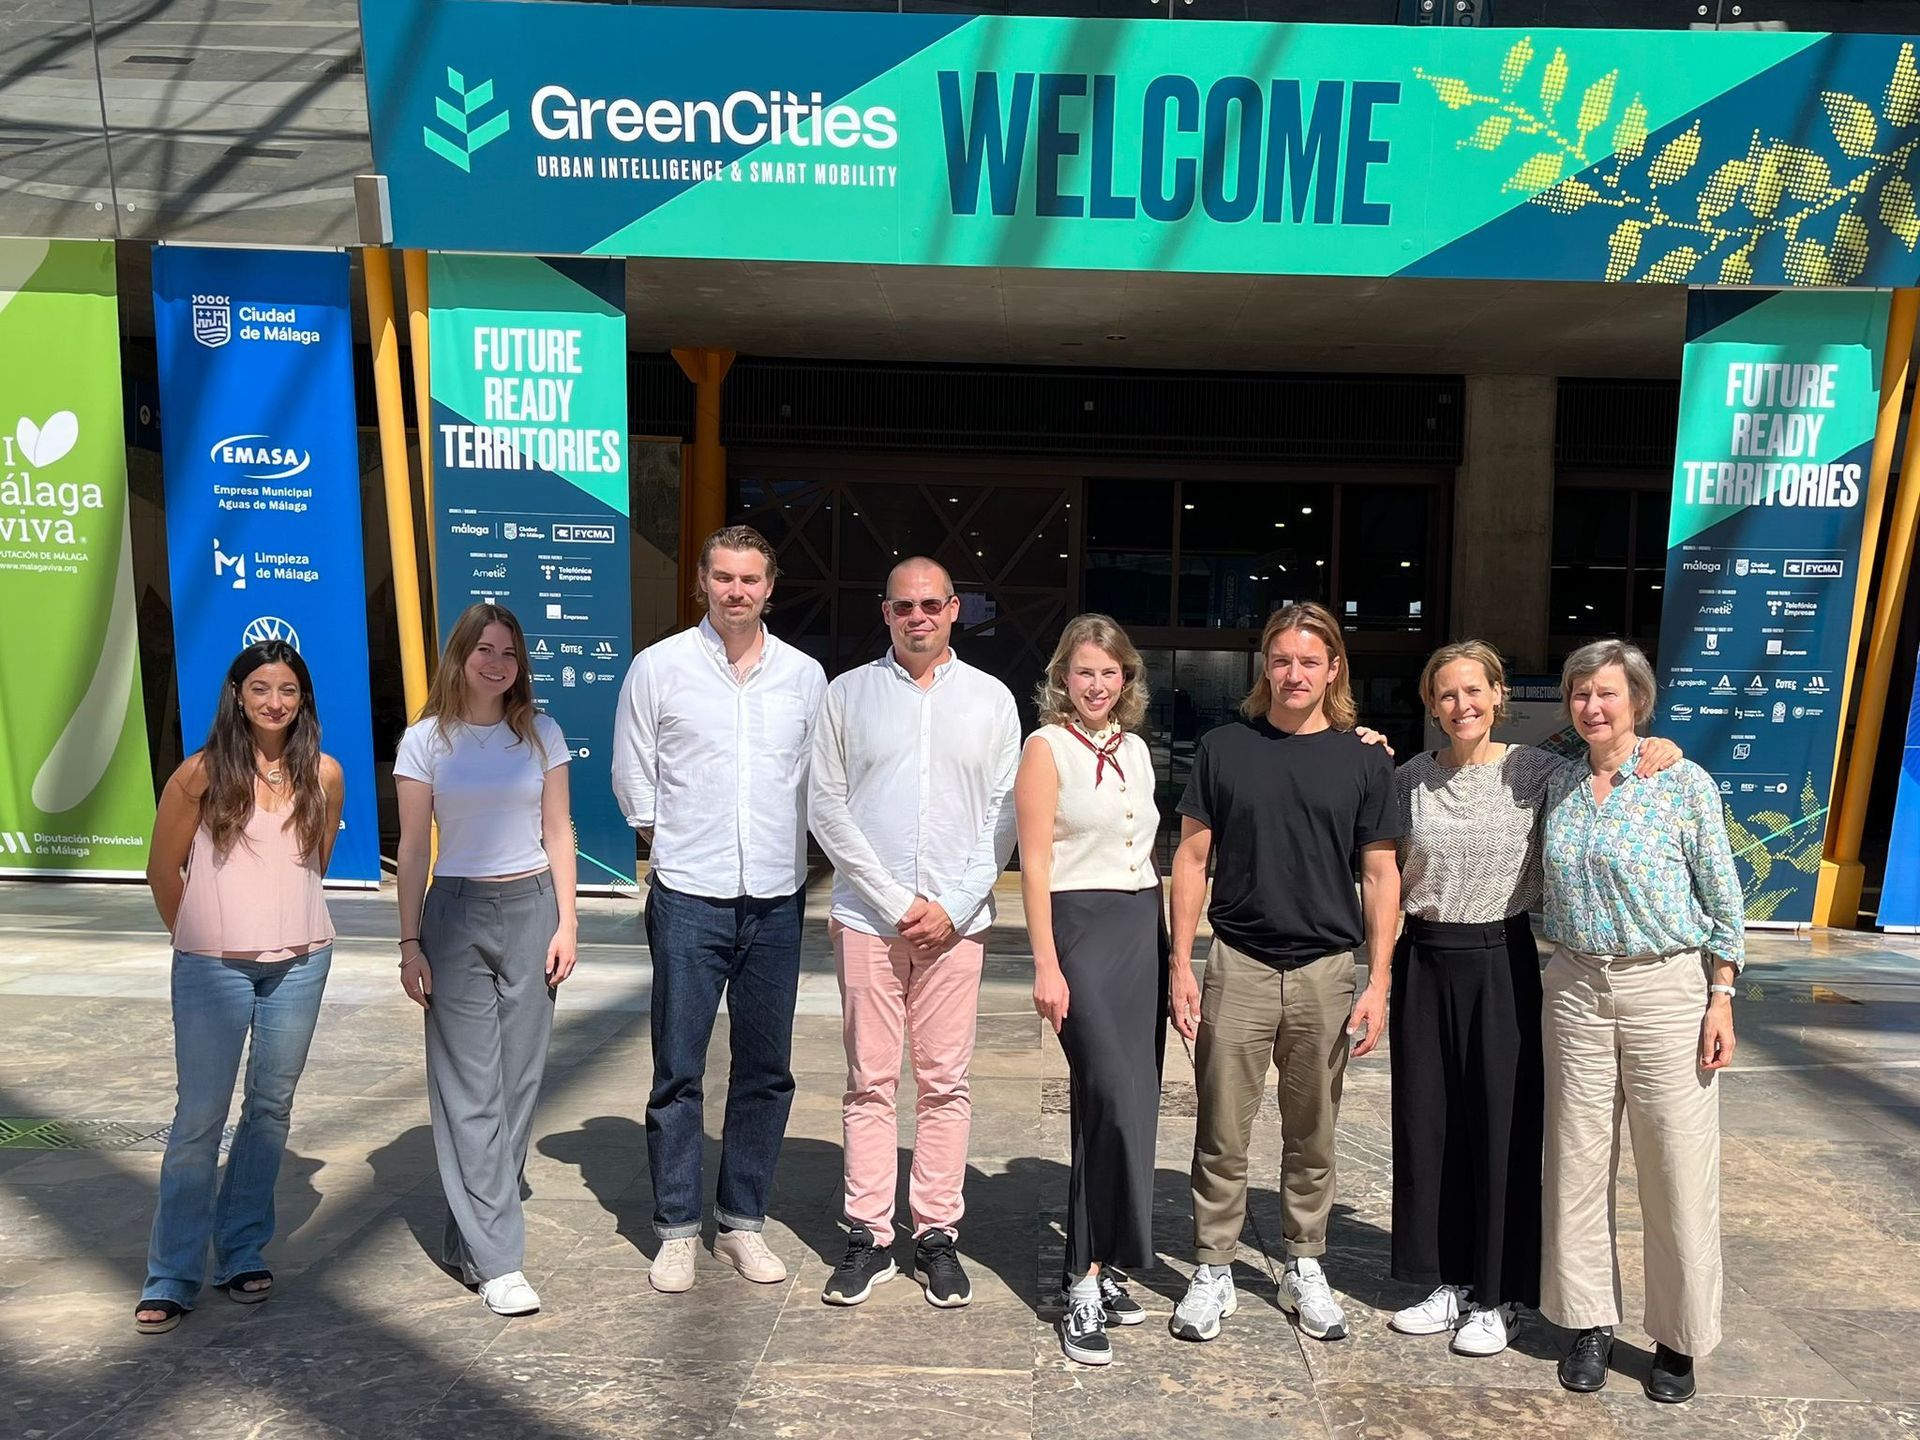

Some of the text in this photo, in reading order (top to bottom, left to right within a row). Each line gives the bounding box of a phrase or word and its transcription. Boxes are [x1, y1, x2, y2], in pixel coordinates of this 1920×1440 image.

[531, 85, 898, 149] GreenCities
[937, 70, 1401, 226] WELCOME
[537, 156, 897, 187] URBAN INTELLIGENCE & SMART MOBILITY
[239, 307, 296, 323] Ciudad
[240, 325, 320, 345] de Málaga
[474, 326, 583, 374] FUTURE
[1725, 362, 1839, 408] FUTURE
[484, 376, 574, 422] READY
[1731, 413, 1825, 457] READY
[3, 436, 16, 466] I
[222, 446, 299, 466] EMASA
[440, 424, 621, 473] TERRITORIES
[213, 484, 312, 498] Empresa Municipal
[1683, 461, 1862, 507] TERRITORIES
[218, 498, 307, 513] Aguas de Málaga
[574, 530, 610, 538] FYCMA
[0, 550, 88, 561] UTACIÓN DE MÁLAGA
[255, 552, 309, 566] Limpieza
[256, 568, 319, 582] de Málaga
[1805, 564, 1837, 573] FYCMA
[34, 832, 143, 846] Diputación Provincial
[36, 845, 90, 858] de Málaga
